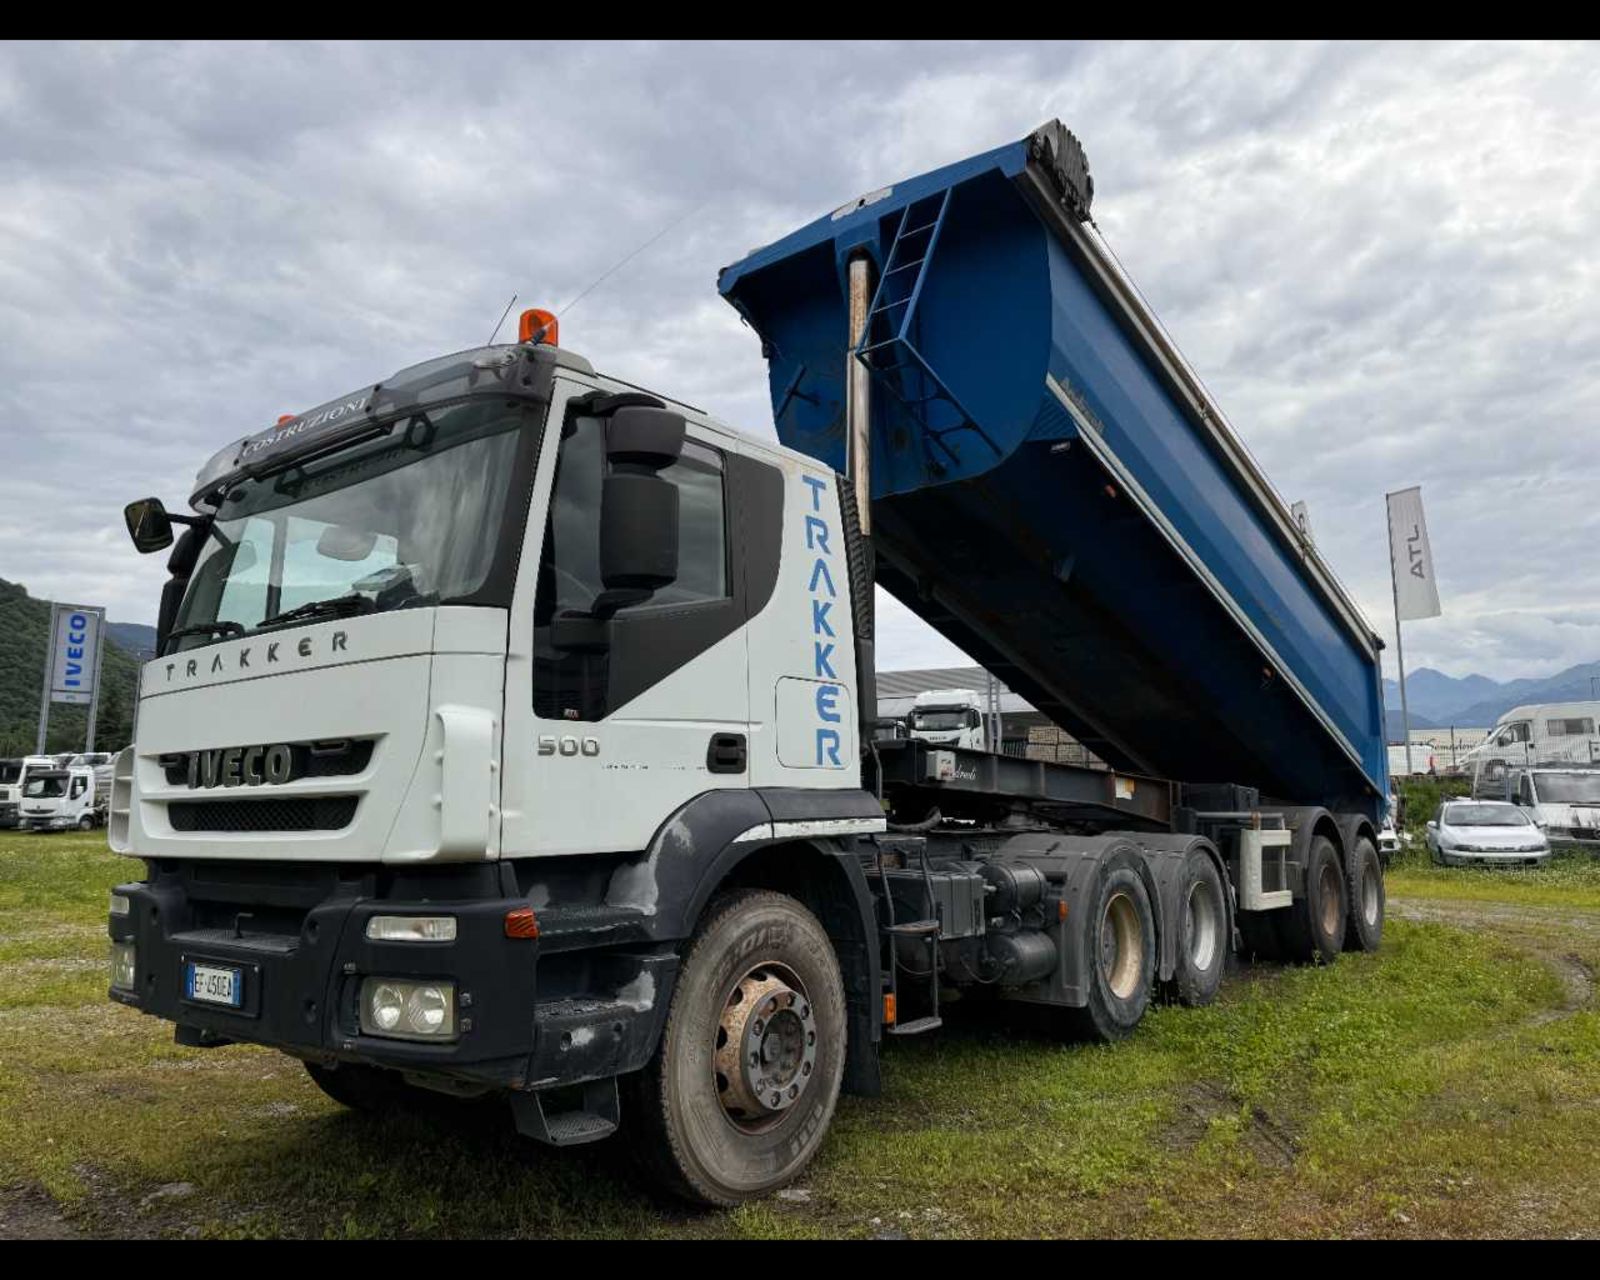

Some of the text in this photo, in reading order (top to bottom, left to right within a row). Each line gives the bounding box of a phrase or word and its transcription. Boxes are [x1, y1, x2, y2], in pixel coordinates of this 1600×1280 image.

[242, 397, 367, 457] COSTRUZIONI
[1407, 524, 1425, 579] ATL
[801, 474, 841, 766] TRAKKER
[64, 614, 87, 687] IVECO
[165, 631, 349, 681] TRAKKER
[187, 744, 293, 789] IVECO
[537, 734, 601, 757] 500
